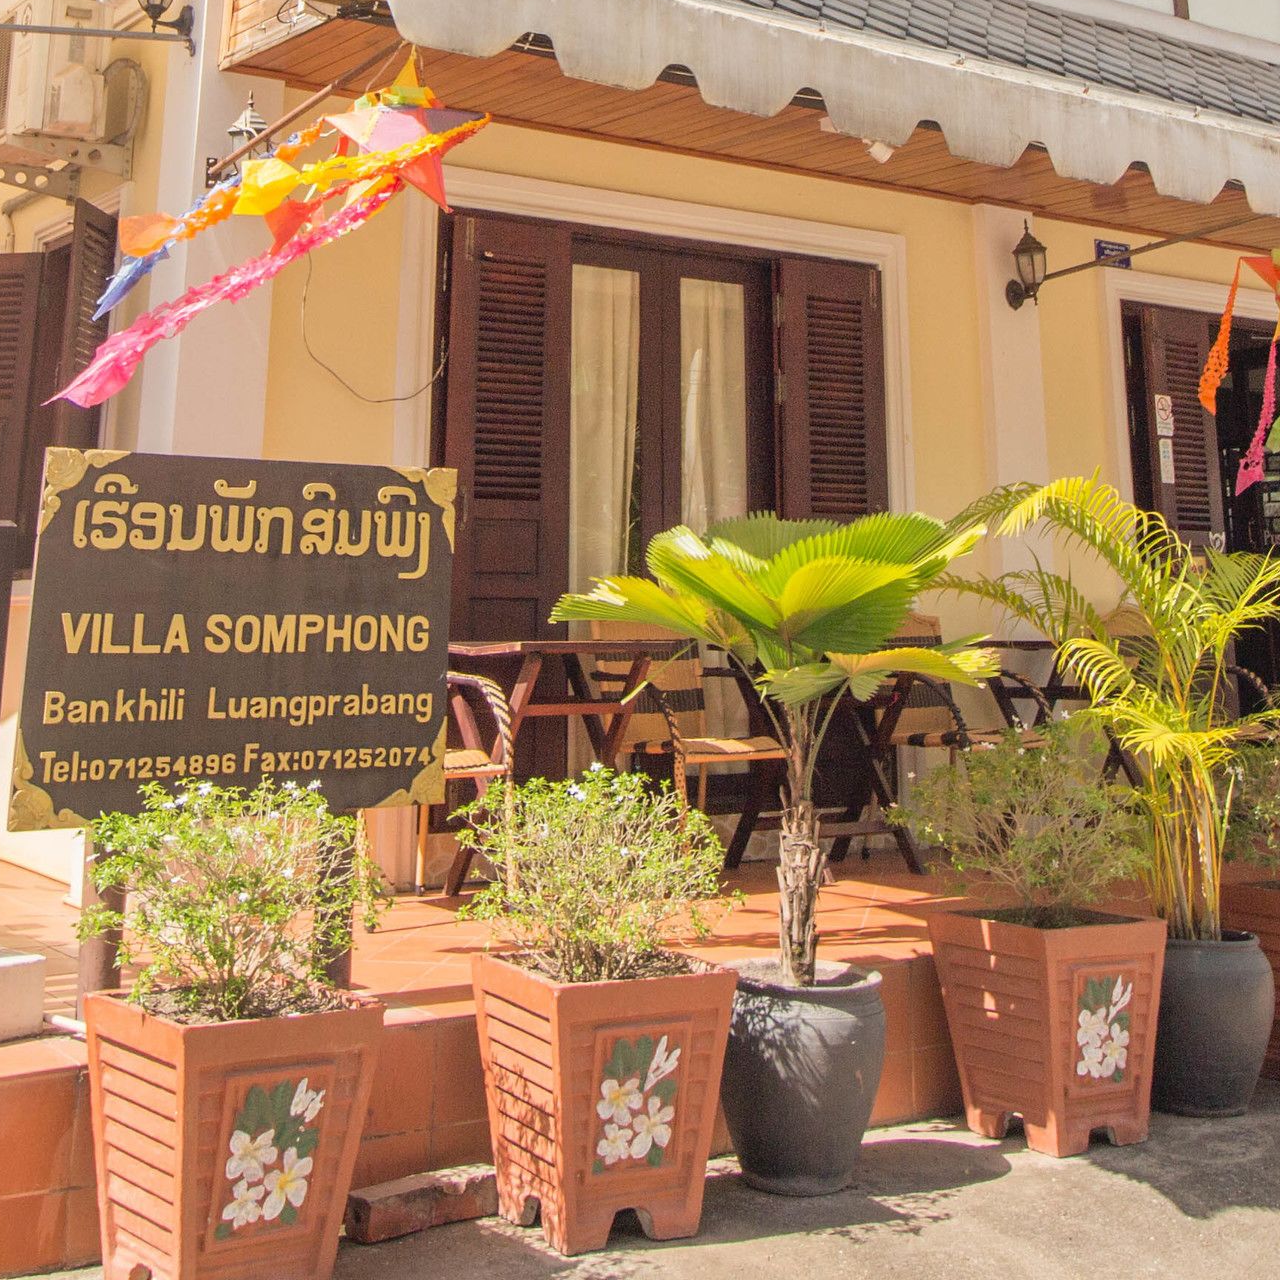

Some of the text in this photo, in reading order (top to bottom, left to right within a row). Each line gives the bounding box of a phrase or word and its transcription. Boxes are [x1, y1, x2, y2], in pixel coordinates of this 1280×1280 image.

[61, 612, 430, 655] VILLA SOMPHONG
[207, 684, 433, 726] Luangprabang
[40, 742, 432, 784] Tel:071254896 Fax:071252074
